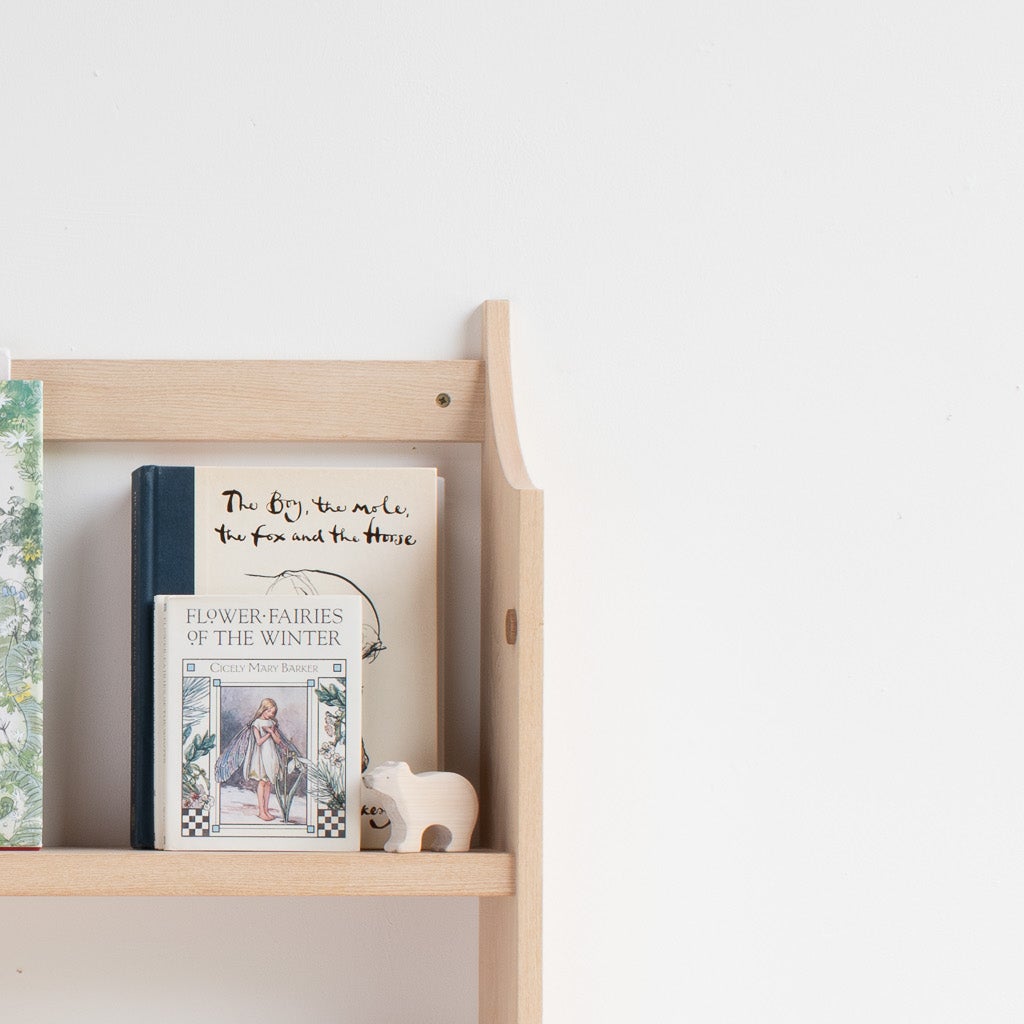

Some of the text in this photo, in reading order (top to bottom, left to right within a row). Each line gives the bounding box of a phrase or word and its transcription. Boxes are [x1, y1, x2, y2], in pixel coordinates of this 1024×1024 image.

[221, 489, 258, 513] The
[266, 490, 309, 522] Boy,
[312, 496, 347, 513] the
[214, 516, 417, 547] the fox and the Horse
[187, 630, 341, 646] OF THE WINTER
[248, 662, 279, 673] MARY
[281, 662, 318, 673] BARKER
